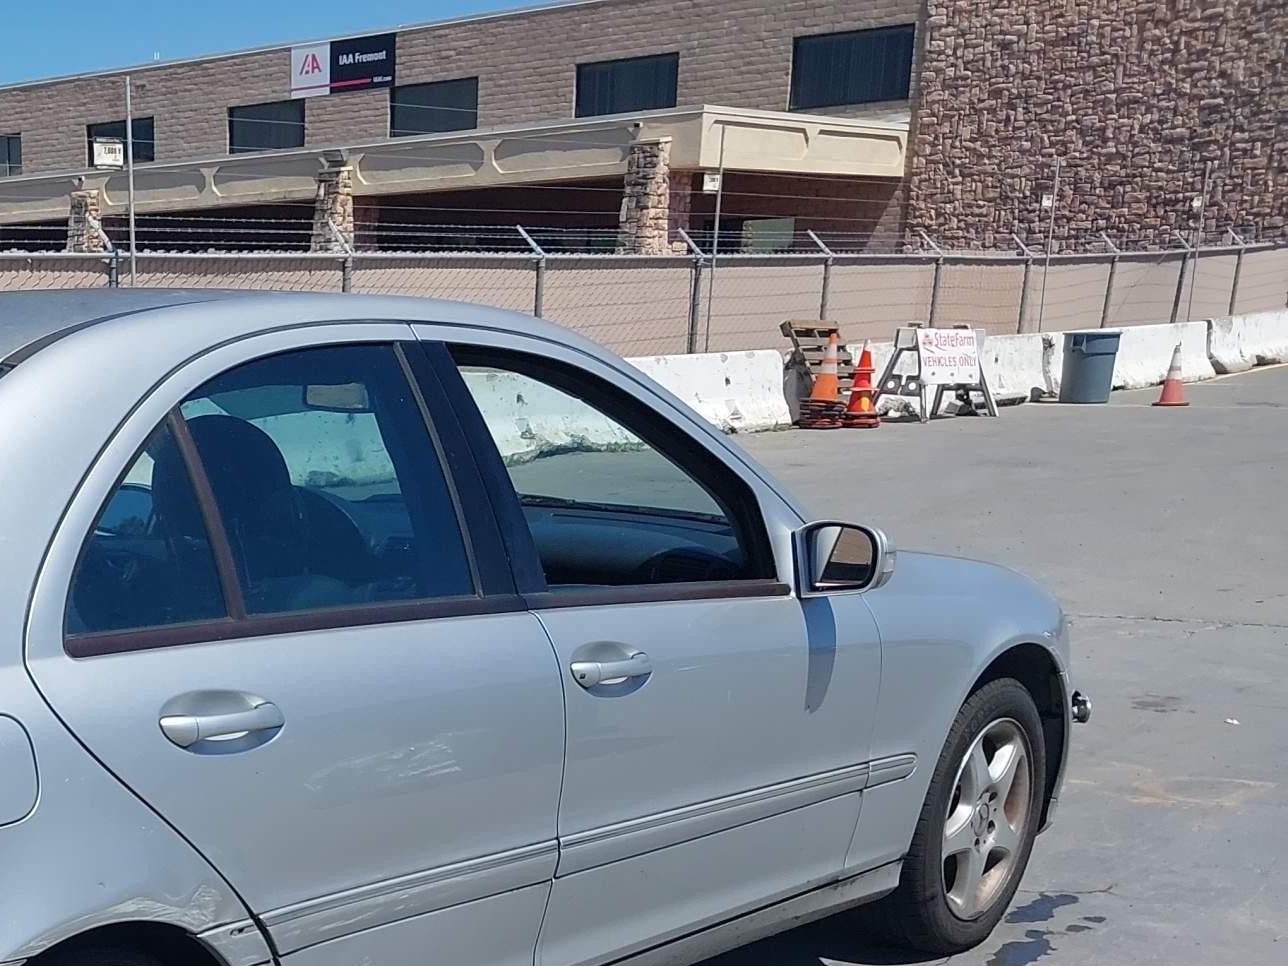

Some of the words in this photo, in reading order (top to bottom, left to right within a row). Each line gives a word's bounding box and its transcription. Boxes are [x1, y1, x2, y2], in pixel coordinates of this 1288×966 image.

[339, 54, 353, 65] IAA
[355, 50, 386, 63] Fremont
[923, 356, 957, 367] VEHICLES
[958, 355, 977, 367] ONLY
